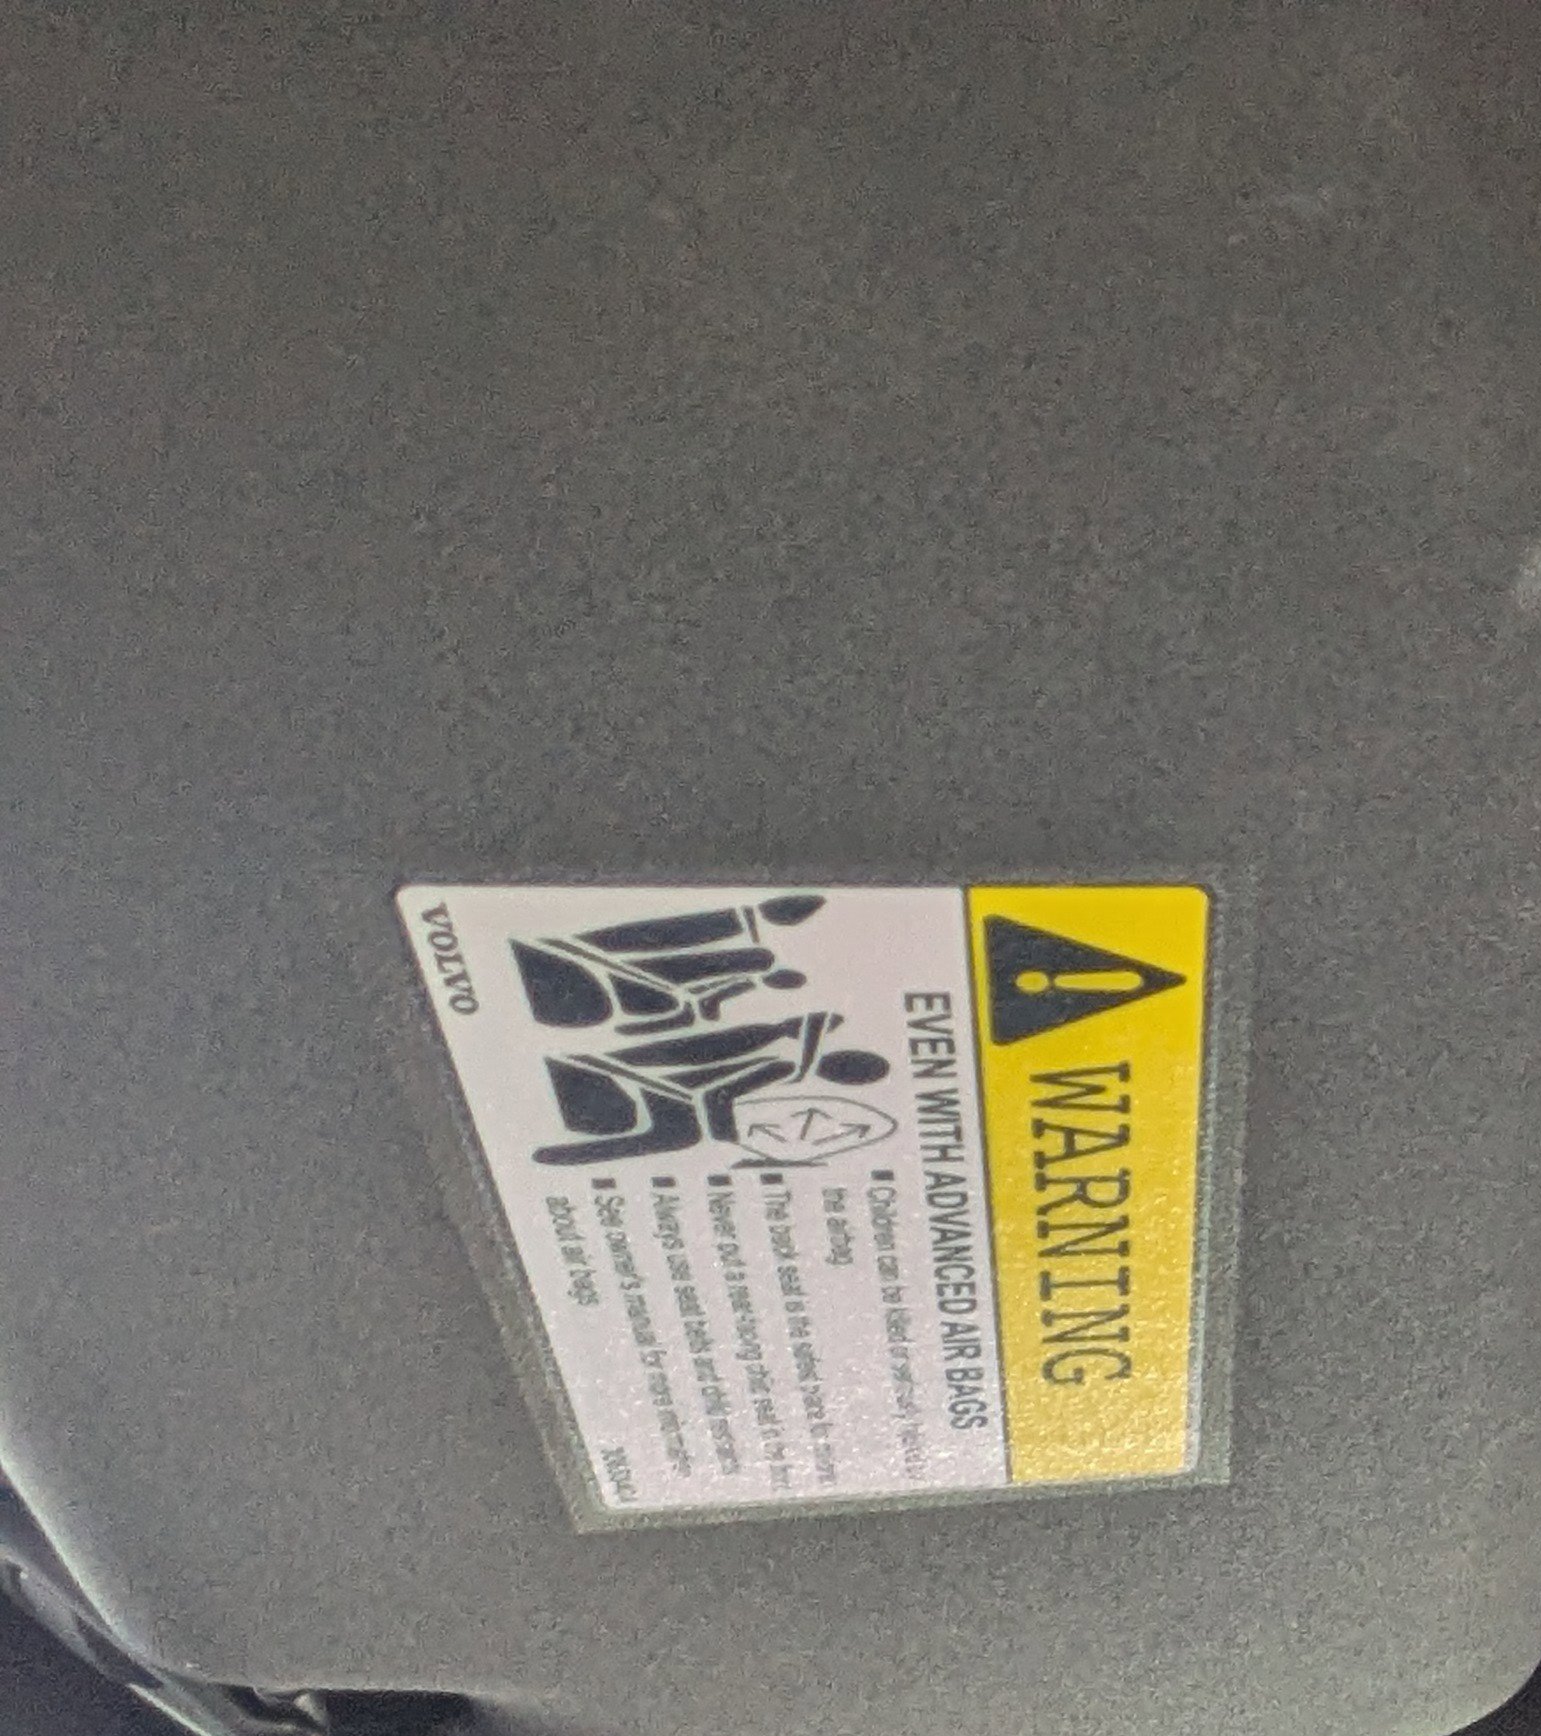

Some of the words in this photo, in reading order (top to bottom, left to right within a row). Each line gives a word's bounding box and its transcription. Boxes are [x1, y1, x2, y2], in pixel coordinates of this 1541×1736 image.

[421, 904, 479, 1014] VOLVO
[904, 992, 956, 1078] EVEN
[916, 1089, 964, 1160] WITH
[594, 1195, 624, 1227] See
[708, 1193, 735, 1239] Never
[764, 1191, 791, 1221] The
[823, 1188, 847, 1212] the
[546, 1196, 584, 1240] about
[650, 1194, 684, 1249] Always
[869, 1187, 896, 1251] Children
[1028, 1063, 1132, 1386] WARNING
[563, 1246, 589, 1265] air
[717, 1243, 746, 1267] put
[770, 1225, 797, 1260] back
[826, 1218, 854, 1265] airbag
[924, 1172, 976, 1314] ADVANCED
[607, 1231, 642, 1290] owner's
[667, 1254, 692, 1281] use
[725, 1272, 745, 1282] a
[878, 1257, 898, 1280] can
[568, 1270, 599, 1307] bags
[777, 1266, 807, 1296] seat
[881, 1287, 908, 1303] be
[674, 1286, 705, 1317] seat
[786, 1302, 807, 1312] is
[624, 1294, 661, 1346] manual
[683, 1320, 711, 1354] belts
[788, 1316, 812, 1338] the
[940, 1321, 981, 1360] AIR
[641, 1351, 668, 1369] for
[693, 1358, 721, 1382] and
[945, 1368, 989, 1430] BAGS
